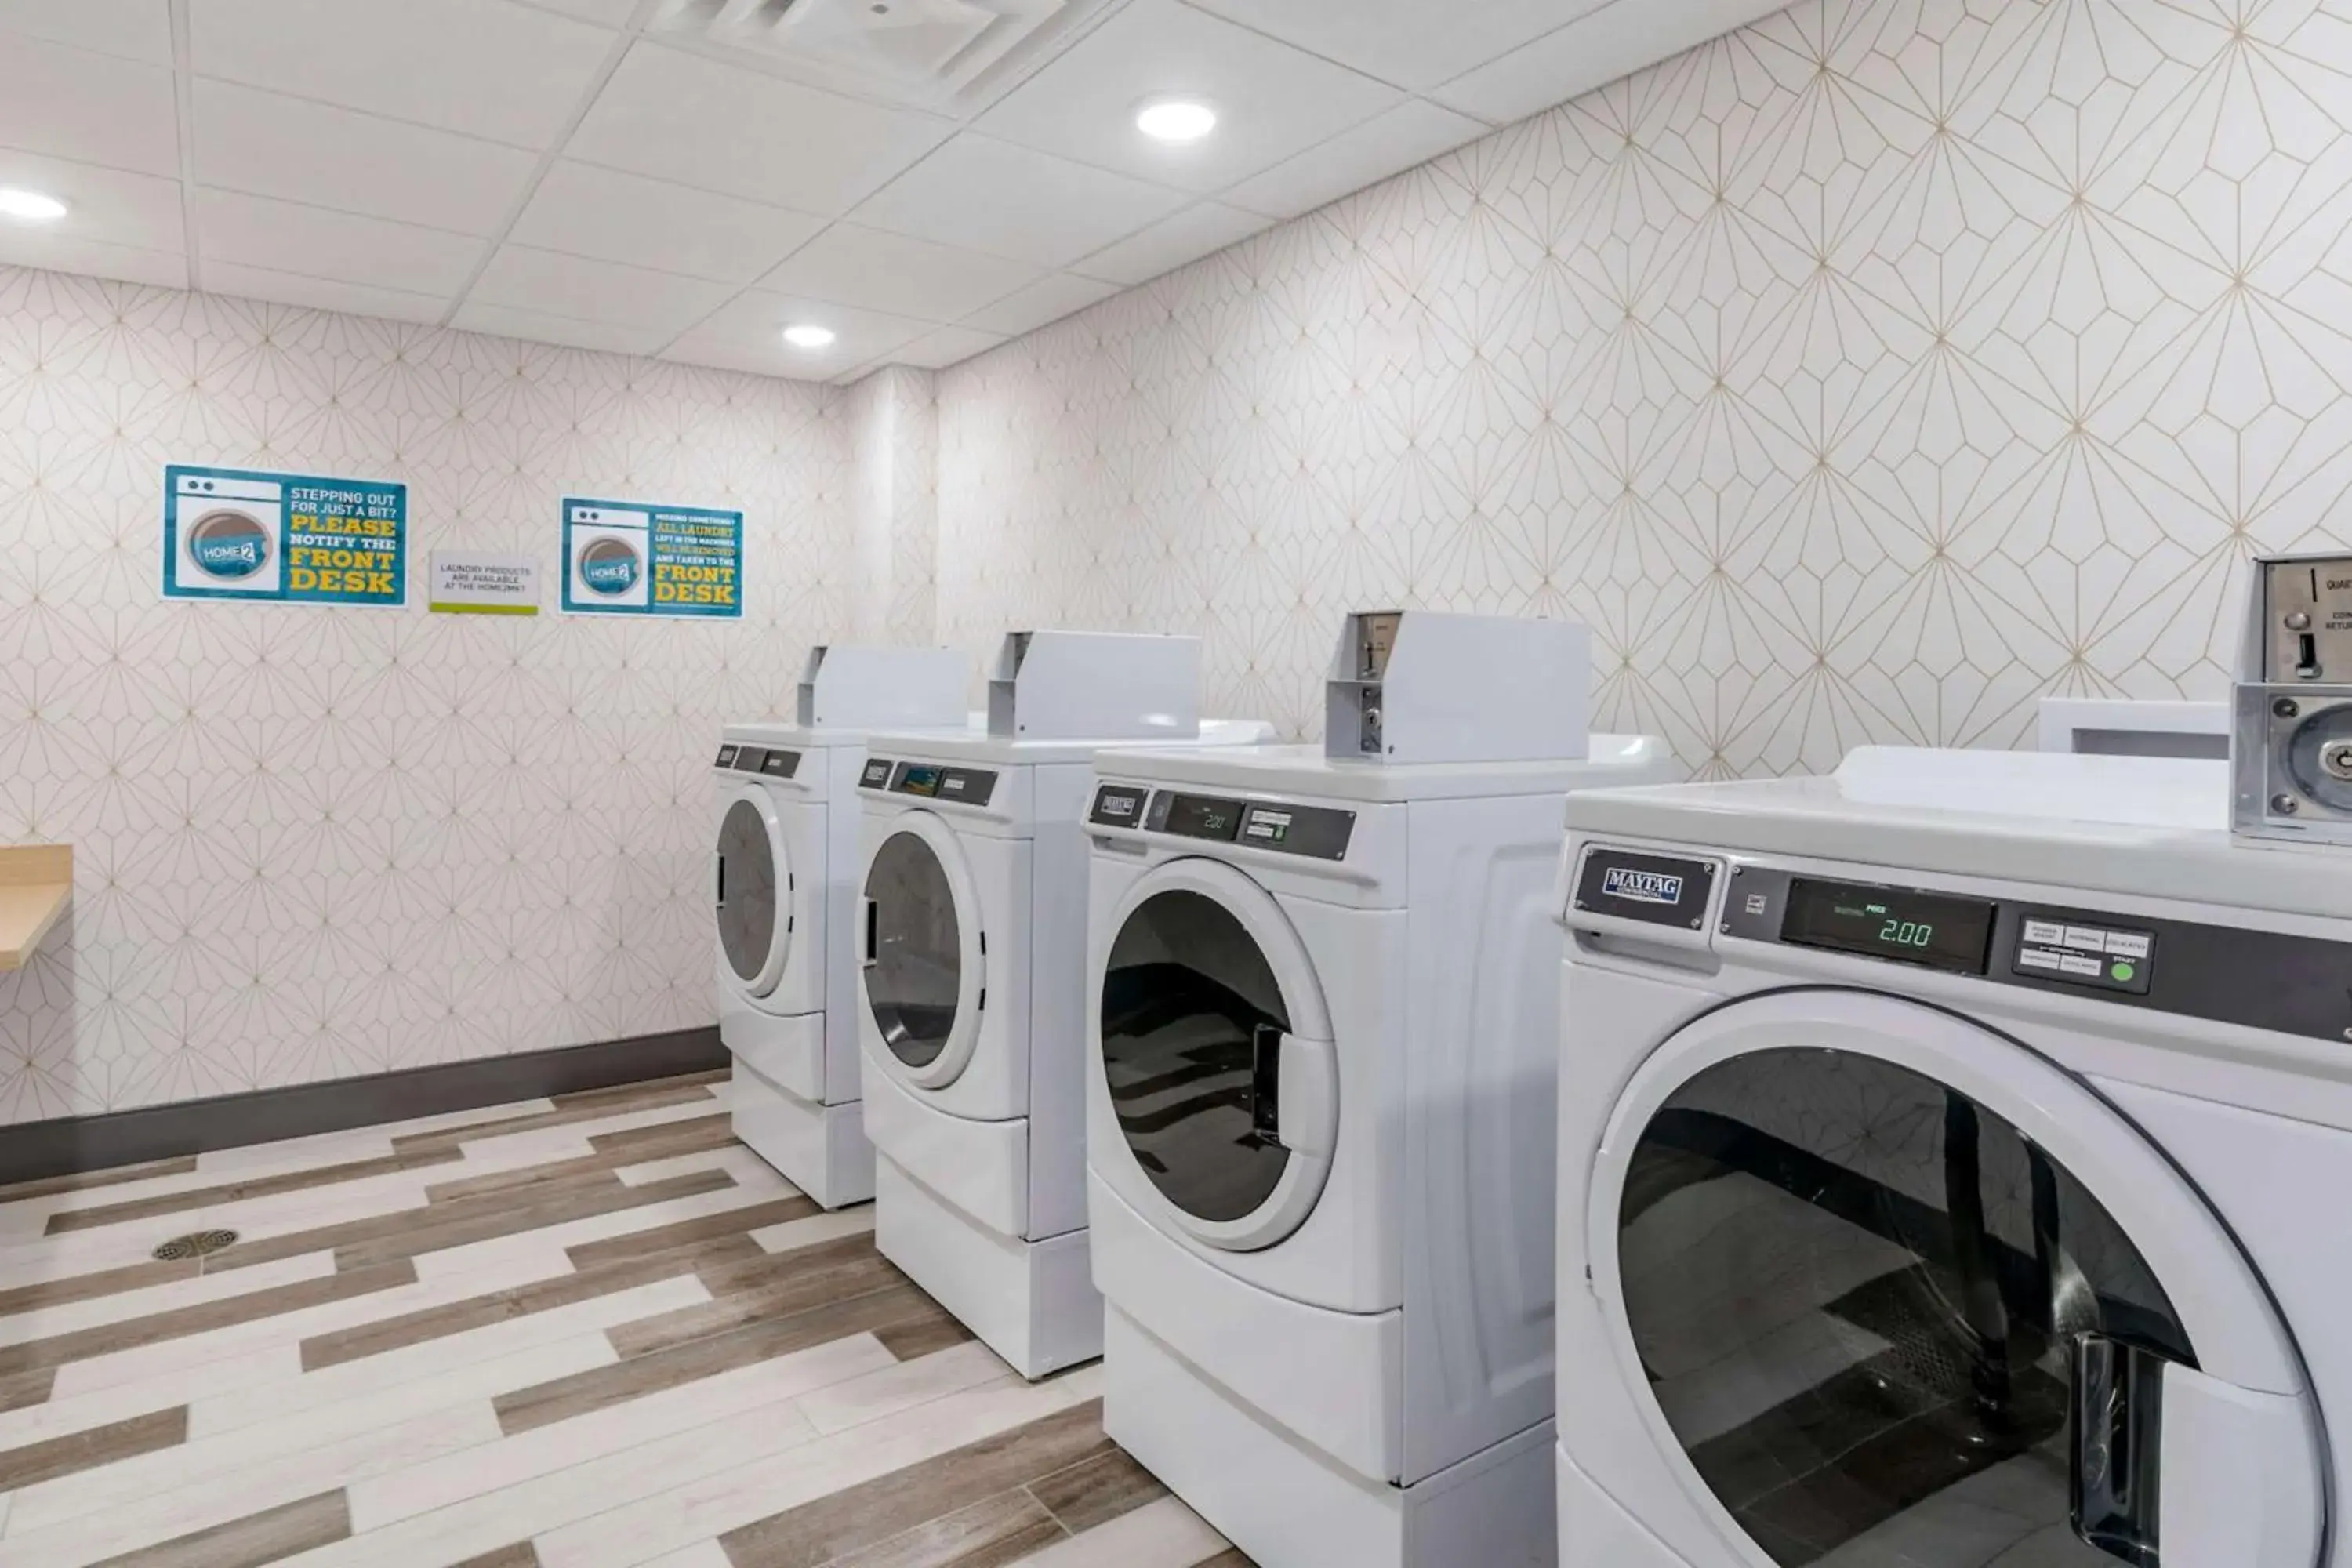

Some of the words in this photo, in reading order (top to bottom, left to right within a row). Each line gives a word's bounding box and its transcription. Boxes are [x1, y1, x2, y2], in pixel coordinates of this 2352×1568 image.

[291, 488, 363, 503] STEPPING
[367, 494, 396, 506] OUT
[291, 501, 318, 513] FOR
[321, 503, 353, 515] JUST
[355, 506, 365, 517] A
[368, 506, 397, 518] BIT?
[291, 514, 396, 536] PLEASE
[681, 524, 734, 538] LAUNDRY
[290, 533, 356, 548] NOTIFY
[361, 538, 396, 550] THE
[289, 546, 395, 570] FRONT
[677, 555, 705, 564] TAKEN
[706, 557, 717, 565] TO
[440, 564, 482, 573] LAUNDRY
[485, 566, 532, 576] PRODUCTS
[452, 573, 469, 582] ARE
[472, 575, 519, 584] AVAILABLE
[655, 564, 735, 583] FRONT
[289, 568, 395, 593] DESK
[444, 581, 455, 590] AT
[459, 582, 474, 591] THE
[2326, 580, 2352, 590] QUAR
[655, 582, 735, 604] DESK
[2325, 622, 2352, 630] RETUR
[1608, 871, 1677, 894] MAYTAG
[1880, 920, 1932, 946] 2.00
